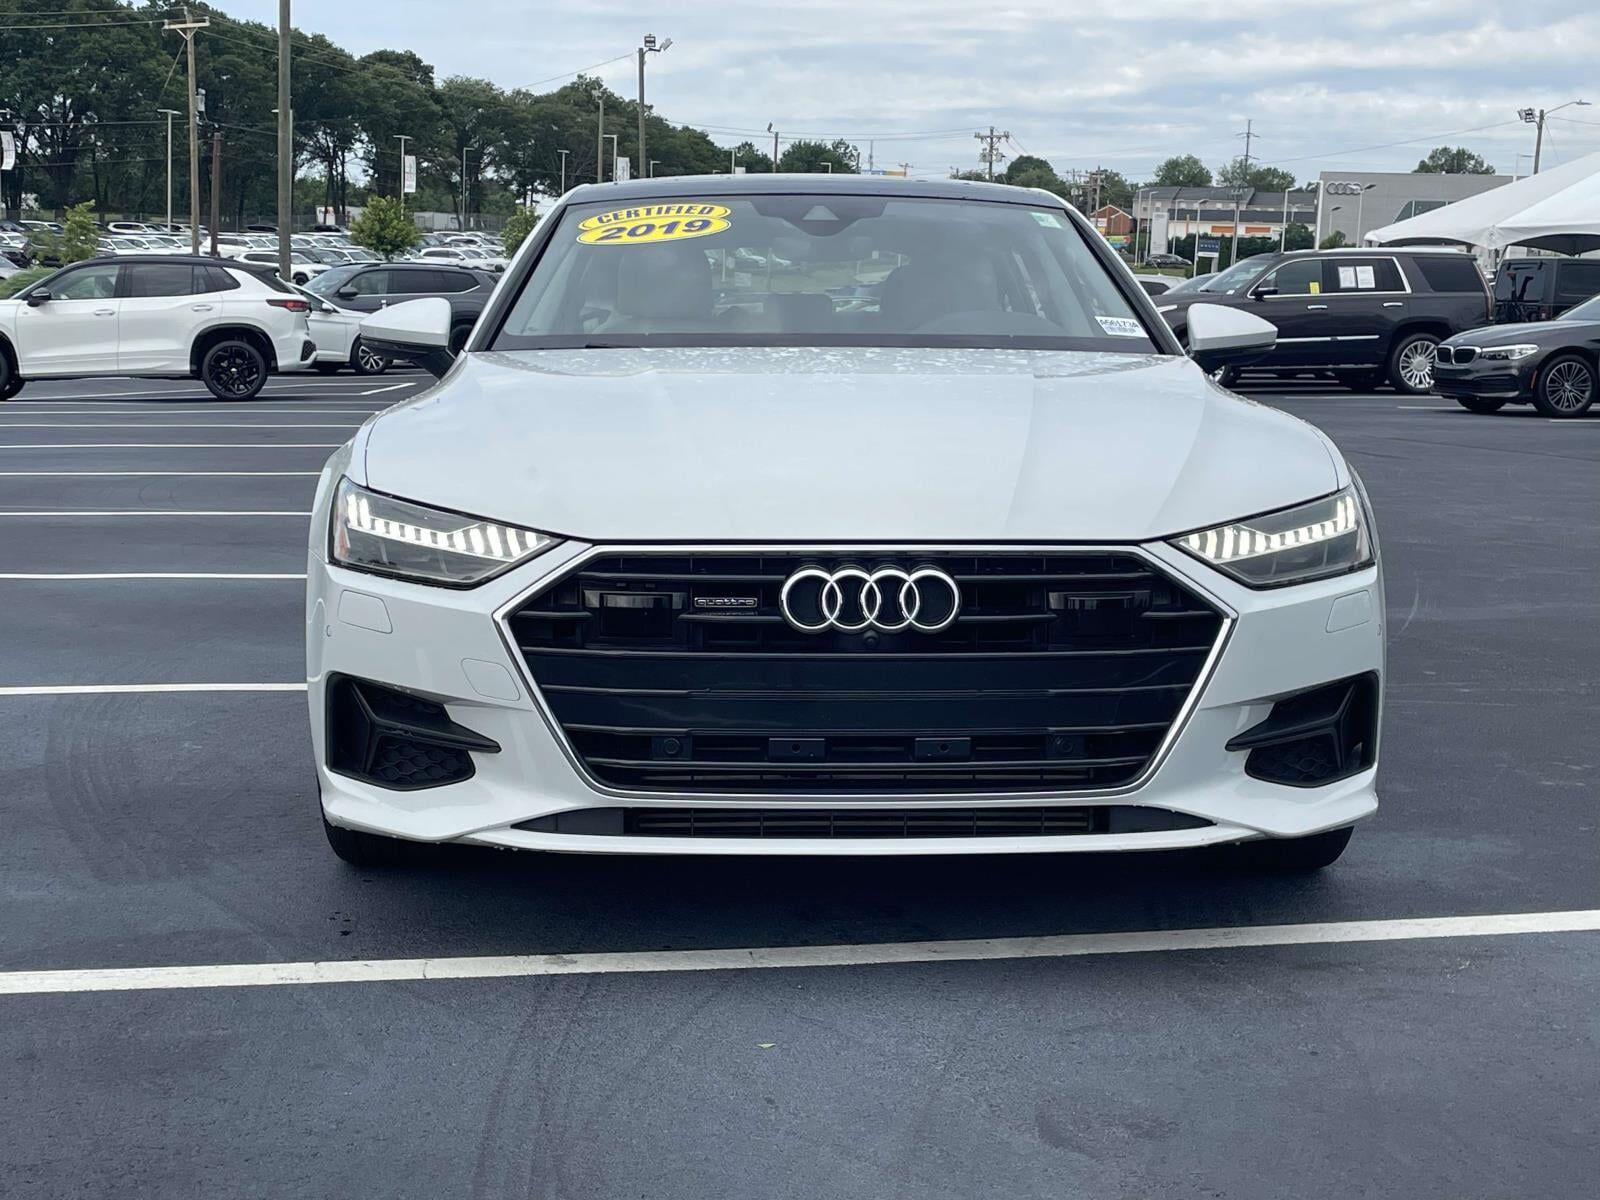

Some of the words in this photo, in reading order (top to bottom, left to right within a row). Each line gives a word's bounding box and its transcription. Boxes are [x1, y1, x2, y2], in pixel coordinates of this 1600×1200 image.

[597, 206, 715, 223] CERTIFIED
[594, 219, 712, 241] 2019
[697, 598, 755, 607] quattro
